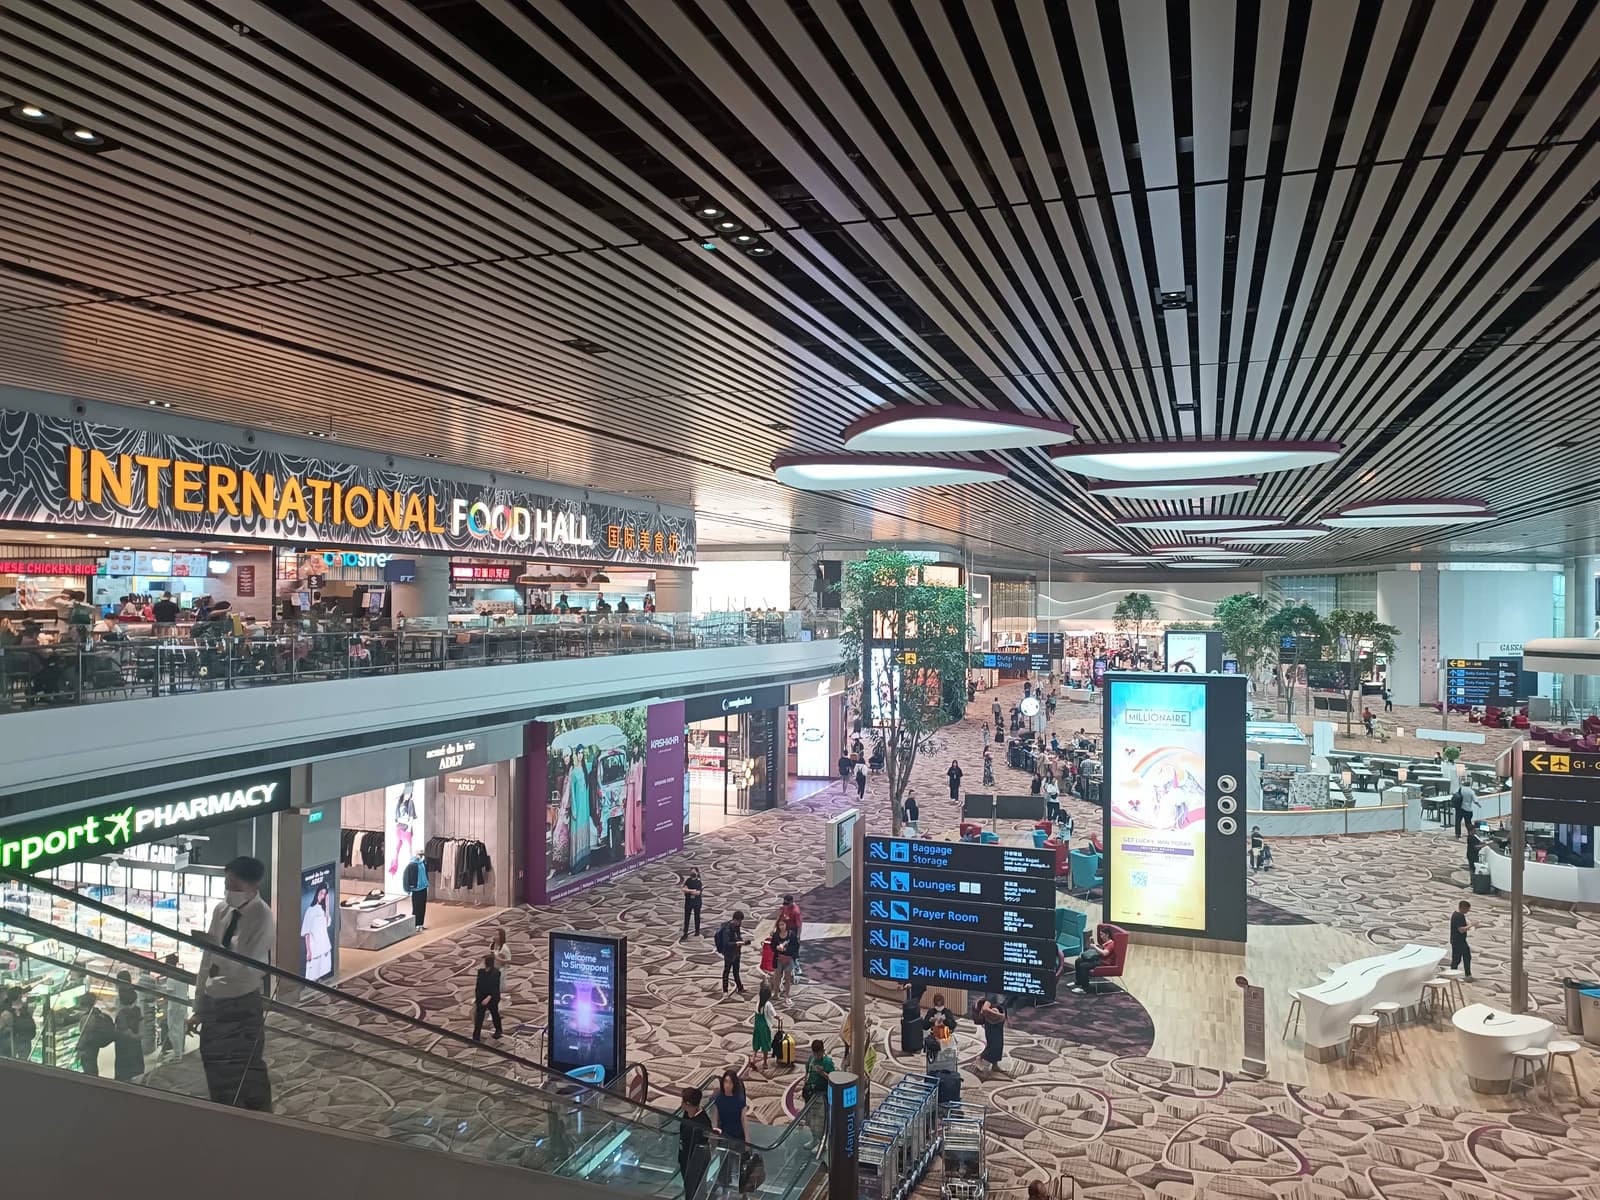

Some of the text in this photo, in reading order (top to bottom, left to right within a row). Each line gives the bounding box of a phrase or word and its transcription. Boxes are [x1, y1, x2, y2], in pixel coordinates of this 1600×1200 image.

[67, 446, 594, 546] INTERNATIONAL FOOD HALL
[608, 525, 679, 554] 国际美食坊
[27, 563, 72, 574] CHICKEN
[75, 564, 97, 575] RICE
[996, 654, 1012, 662] Duty
[1128, 711, 1188, 724] MILLIONAIRE
[438, 754, 464, 770] ADLV
[1573, 760, 1585, 769] G1
[0, 783, 280, 869] rport PHARMACY
[912, 843, 953, 856] Baggage
[912, 855, 948, 867] Storage
[912, 878, 957, 892] Lounges
[912, 907, 979, 923] Prayer Room
[912, 936, 965, 952] 24hr Food
[563, 951, 597, 963] Welcome
[561, 959, 609, 973] to Singapore!
[912, 966, 937, 978] 24hr
[939, 968, 988, 984] Minimart
[847, 1111, 856, 1157] Trolleys
